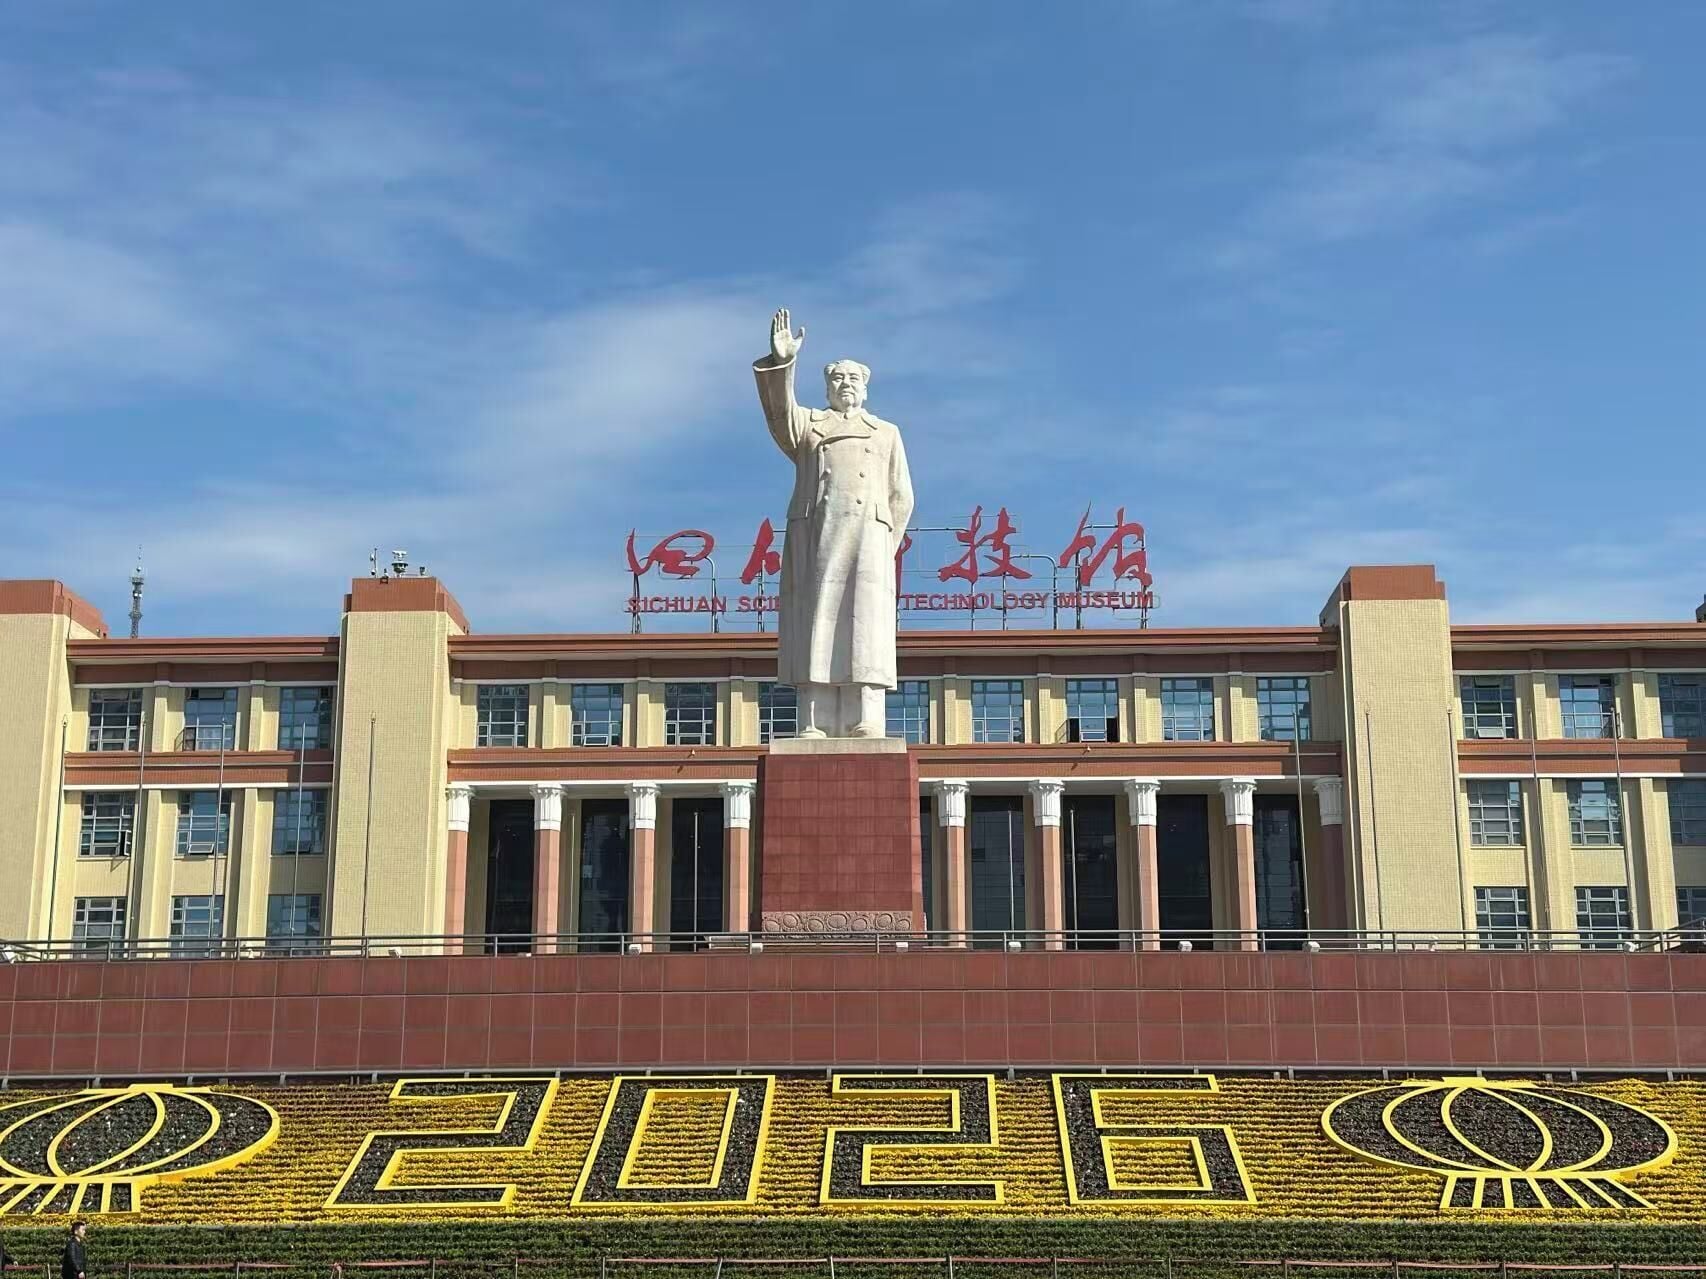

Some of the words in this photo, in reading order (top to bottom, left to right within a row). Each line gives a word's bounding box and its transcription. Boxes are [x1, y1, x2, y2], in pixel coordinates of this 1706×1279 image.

[628, 595, 727, 613] SICHUAN
[902, 592, 1049, 609] TECHNOLOGY
[1058, 590, 1154, 609] MUSEUM
[323, 1073, 1258, 1210] 2026
